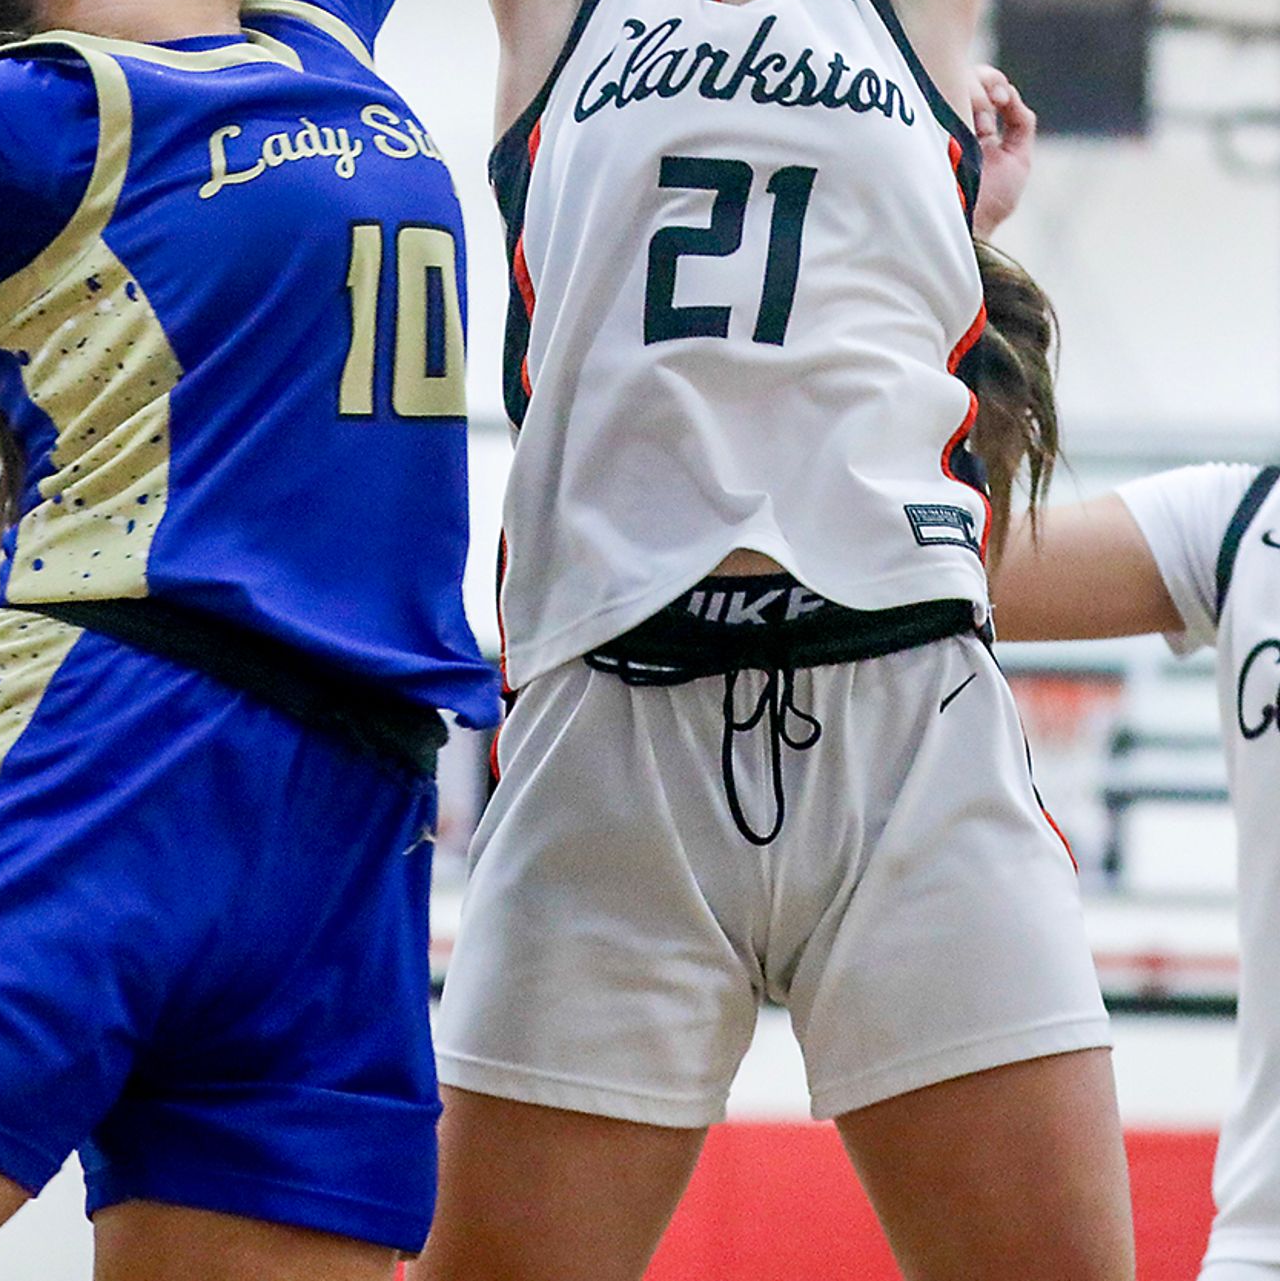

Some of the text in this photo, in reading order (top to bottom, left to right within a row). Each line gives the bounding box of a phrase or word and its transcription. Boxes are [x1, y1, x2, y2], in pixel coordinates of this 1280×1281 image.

[574, 15, 915, 127] Clarkston
[199, 118, 363, 199] Lady
[338, 222, 467, 418] 10
[643, 156, 818, 346] 21
